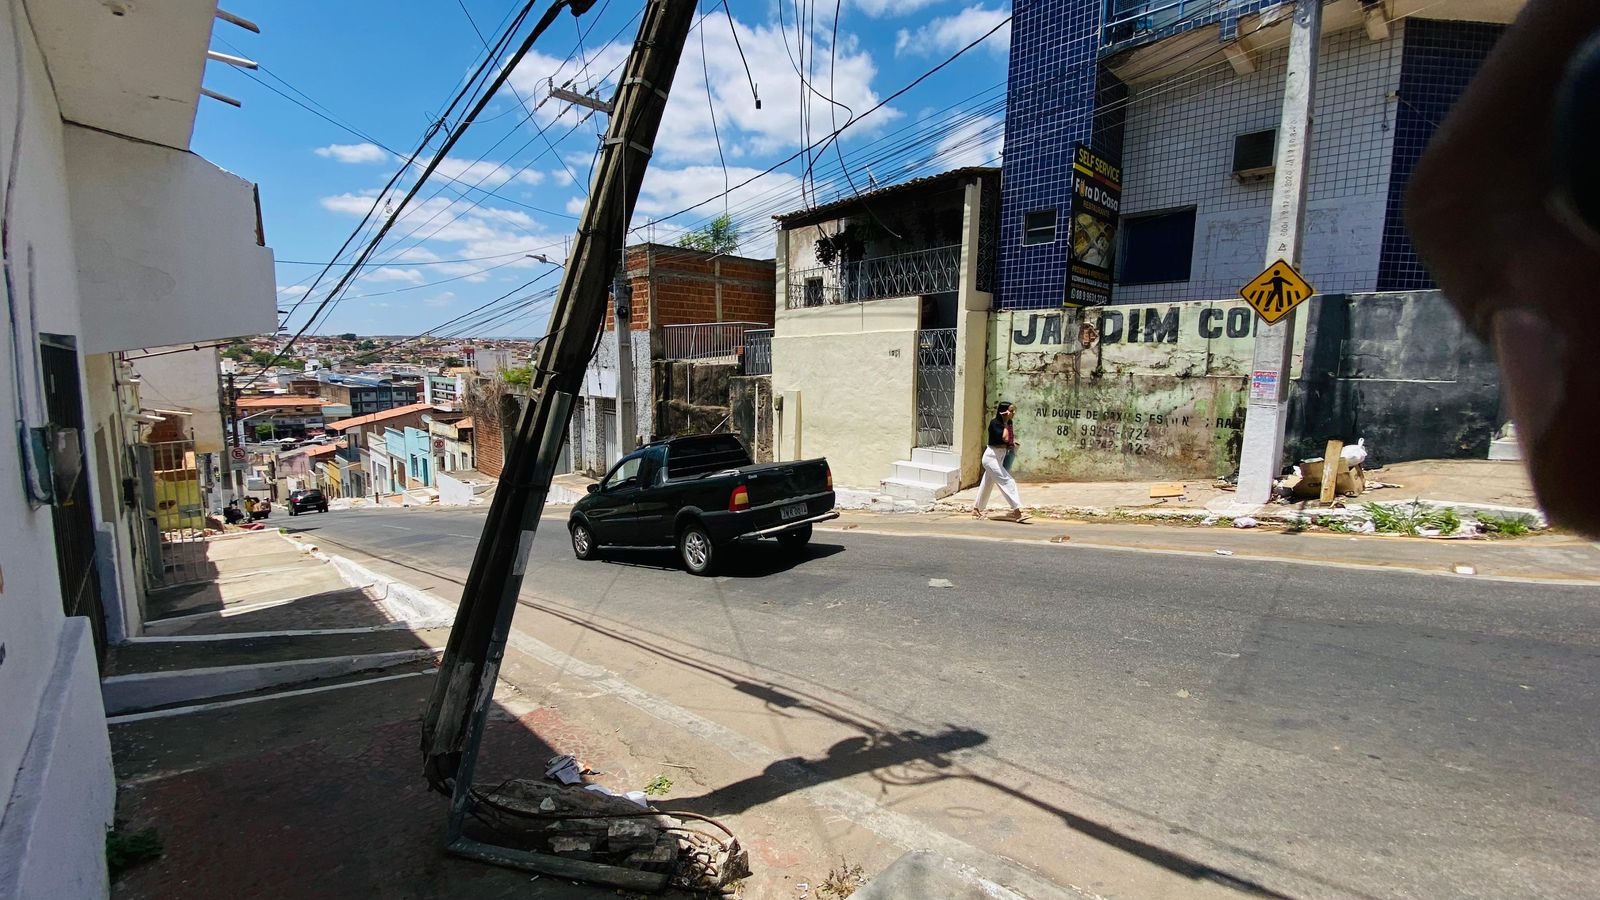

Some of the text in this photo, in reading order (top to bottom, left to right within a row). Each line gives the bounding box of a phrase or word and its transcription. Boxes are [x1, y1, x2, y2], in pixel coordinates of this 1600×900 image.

[1078, 148, 1120, 183] SELF SERVICE
[1102, 191, 1119, 212] Casa
[1198, 307, 1257, 339] CO
[1036, 408, 1048, 418] AV
[1052, 408, 1081, 420] DUQUE
[1086, 410, 1098, 421] DE
[1056, 425, 1069, 436] 88
